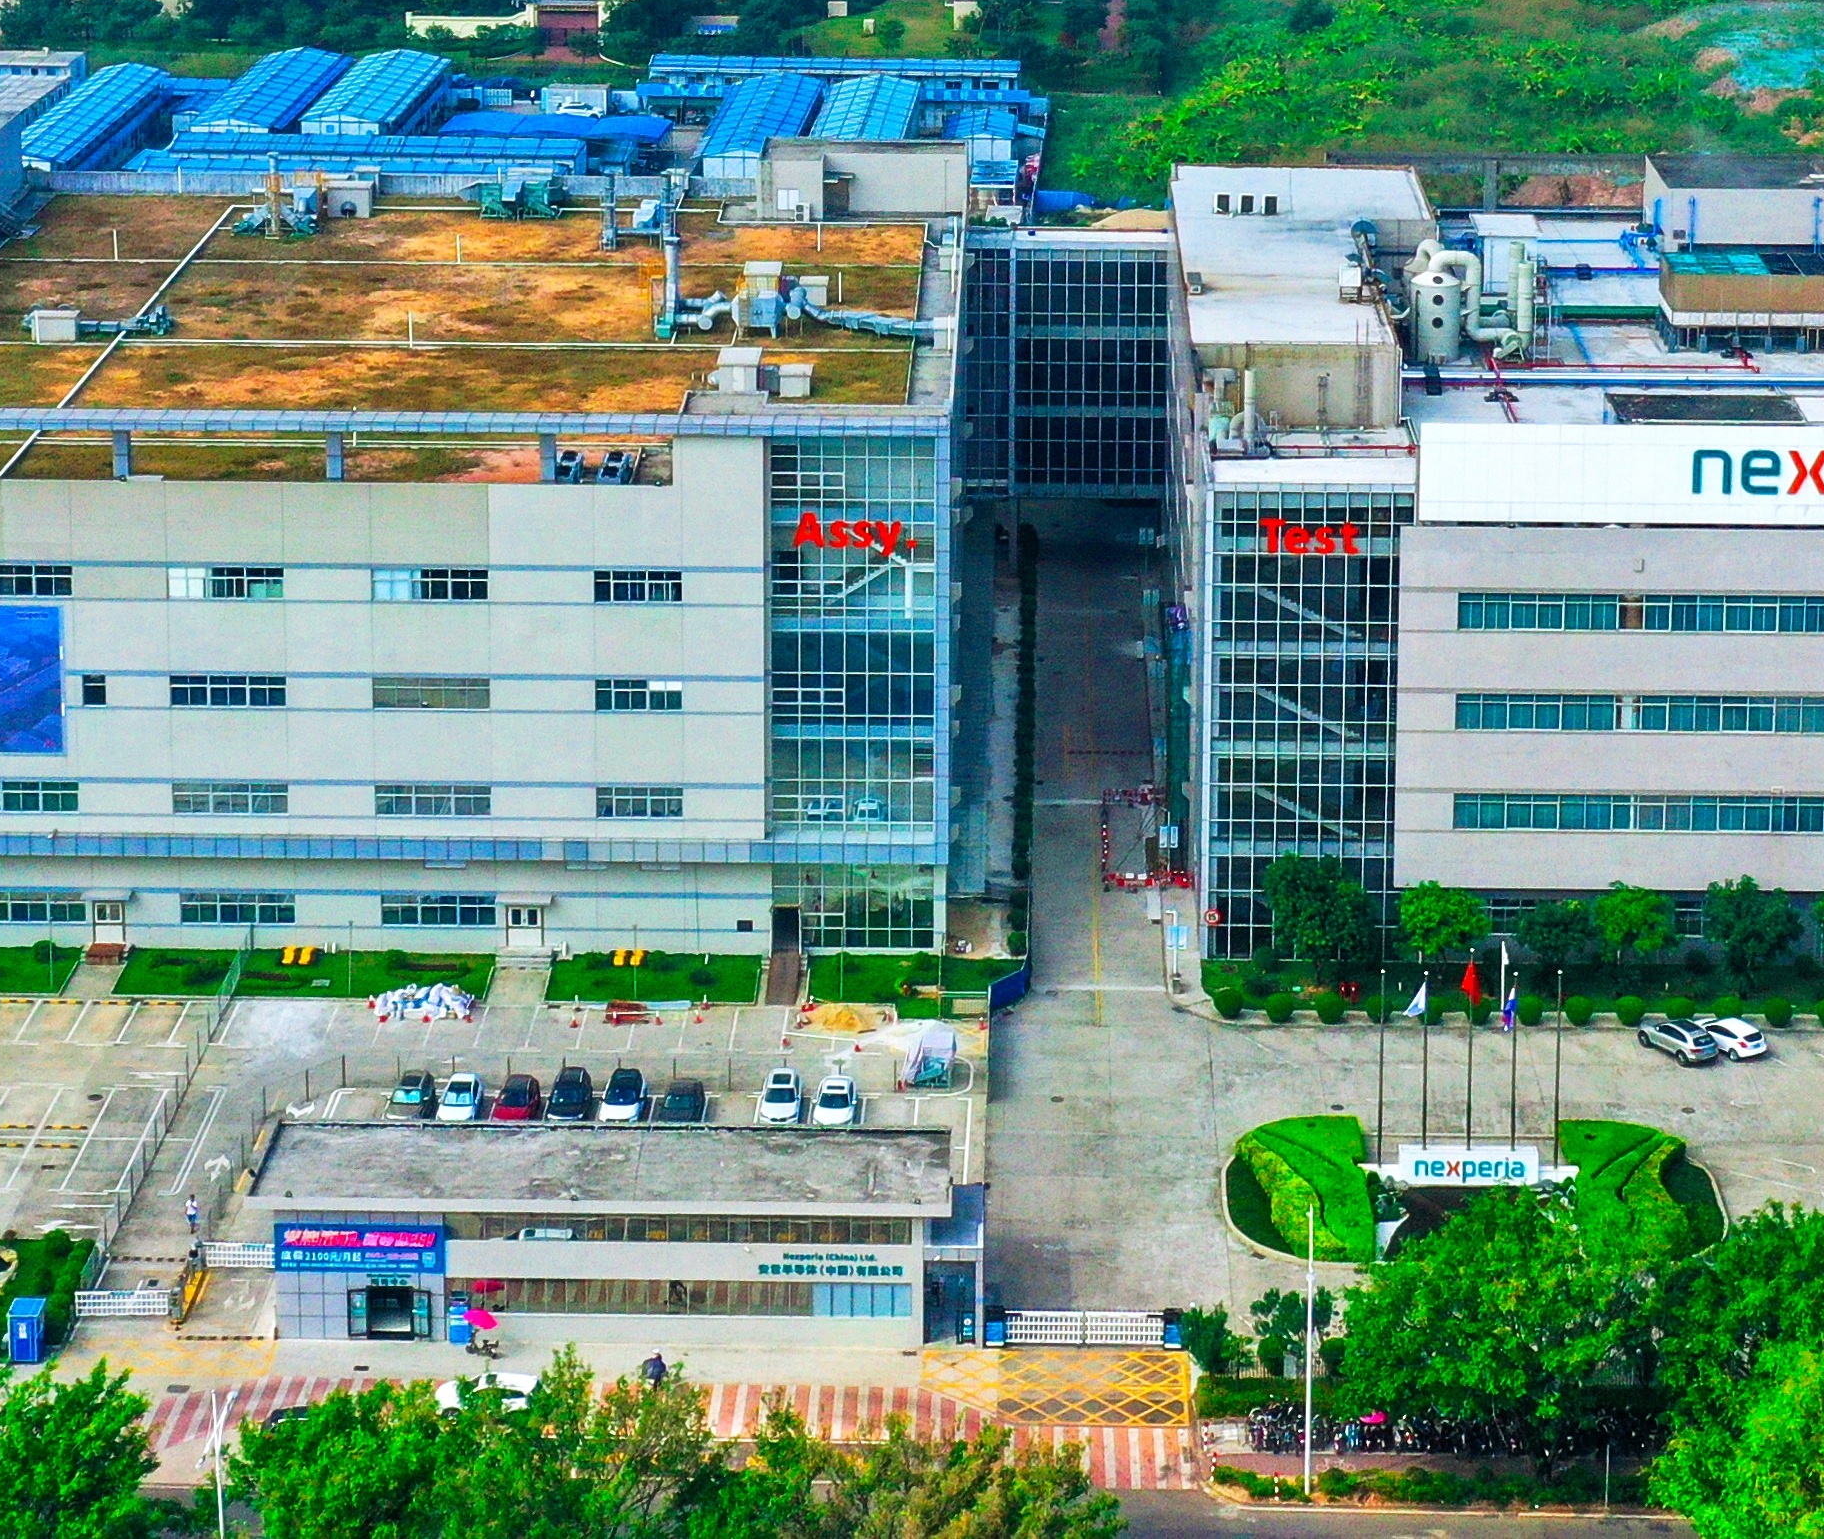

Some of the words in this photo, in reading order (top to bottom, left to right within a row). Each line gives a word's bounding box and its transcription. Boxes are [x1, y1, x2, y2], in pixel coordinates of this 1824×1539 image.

[793, 512, 918, 557] Assy.
[1260, 518, 1360, 556] Test
[1414, 1157, 1526, 1183] nexperia
[783, 1252, 824, 1261] Nexperia
[826, 1252, 858, 1262] (China)
[860, 1253, 877, 1261] Ltd.
